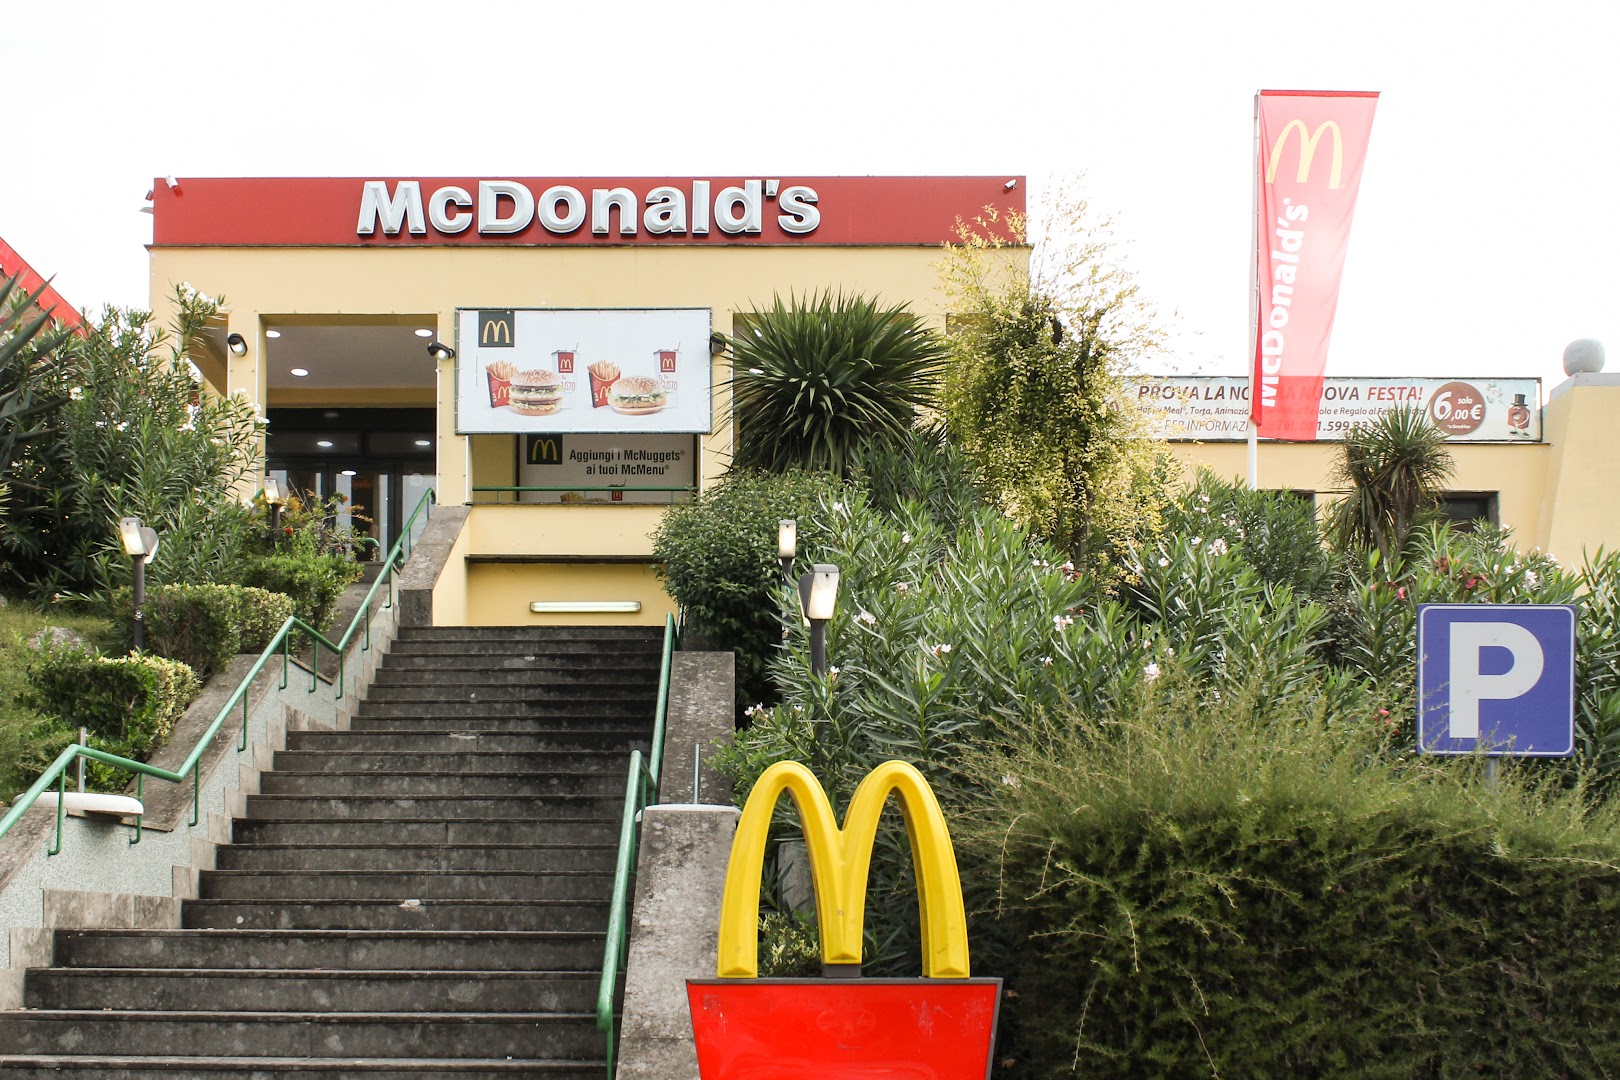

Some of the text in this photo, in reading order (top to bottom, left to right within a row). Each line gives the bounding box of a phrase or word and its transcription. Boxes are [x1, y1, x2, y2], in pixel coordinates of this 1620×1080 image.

[357, 179, 820, 234] McDonald's
[1204, 386, 1225, 400] LA
[1367, 386, 1423, 401] FESTA!
[1457, 396, 1473, 404] solo
[1340, 407, 1367, 417] Regalo
[1368, 407, 1376, 415] al
[569, 449, 614, 463] Aggiungi
[617, 449, 621, 460] i
[586, 464, 596, 475] ai
[599, 464, 618, 475] tuoi
[1450, 622, 1544, 738] P
